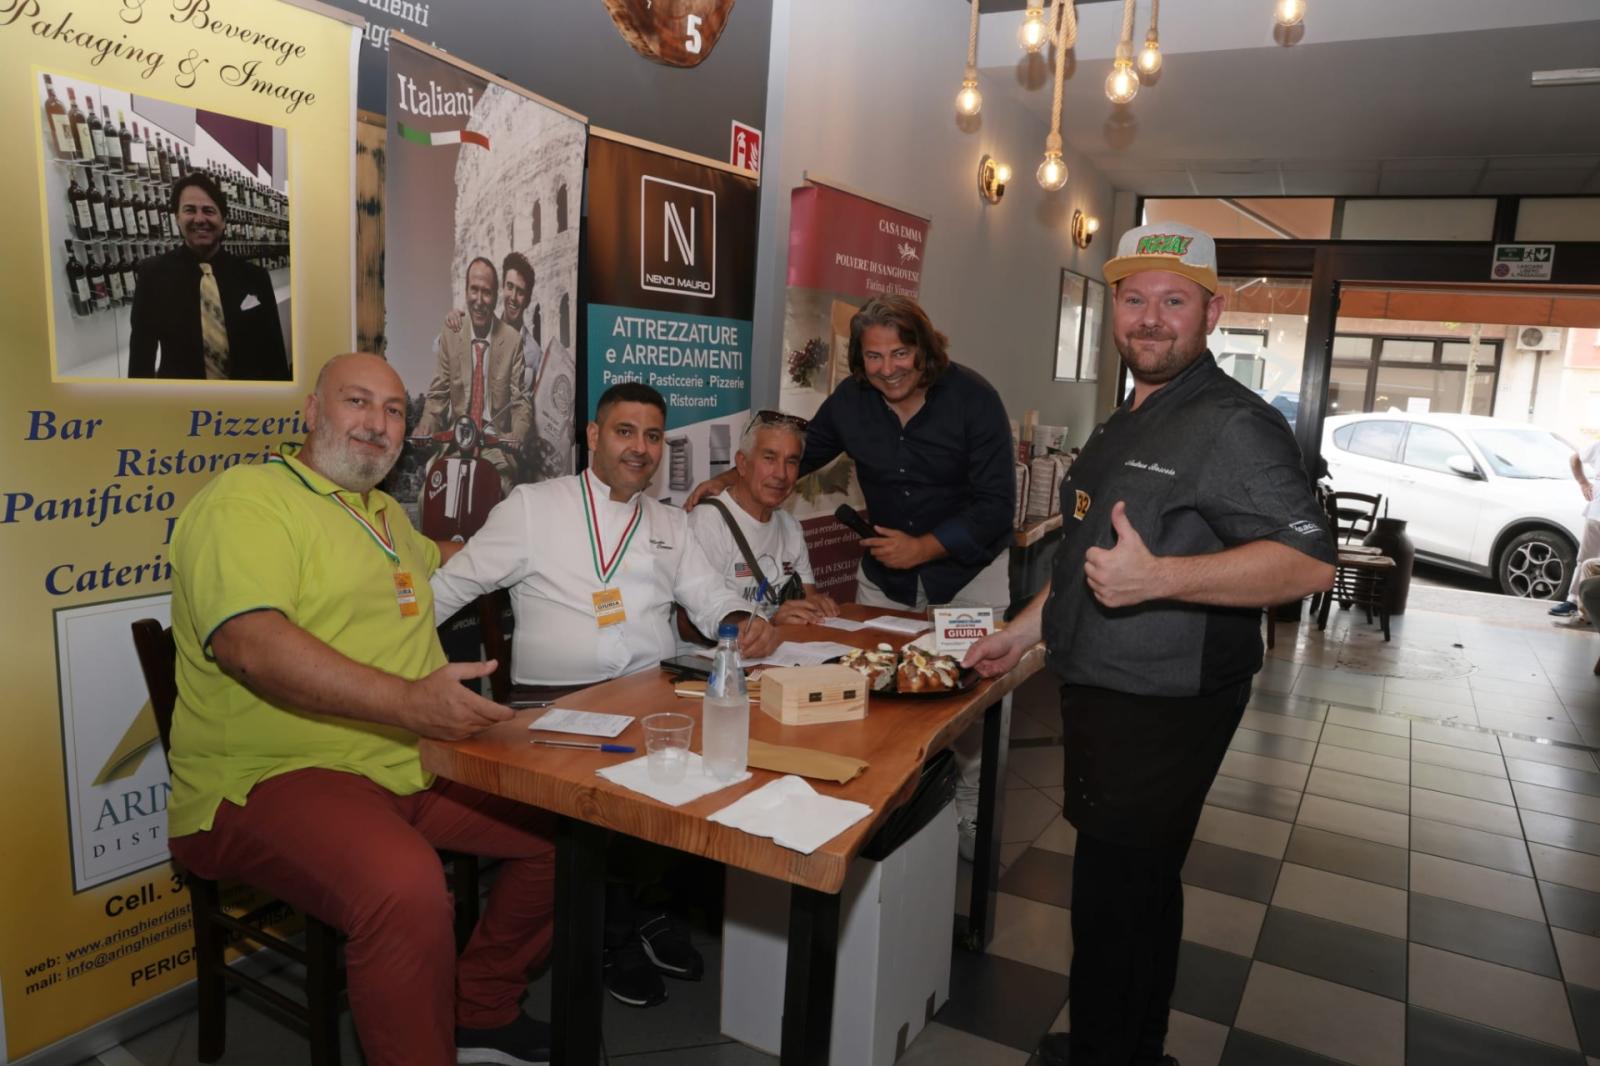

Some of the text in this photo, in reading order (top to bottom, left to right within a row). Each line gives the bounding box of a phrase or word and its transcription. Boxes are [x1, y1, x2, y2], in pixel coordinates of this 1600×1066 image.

[170, 0, 307, 65] Beverage
[685, 14, 702, 54] 5
[0, 1, 316, 114] Pakaging & Image
[397, 73, 474, 117] Italiani
[664, 201, 696, 266] N
[879, 219, 922, 243] CASA EMMA
[835, 253, 868, 272] POLVERE
[646, 273, 710, 291] NENCI MAURO
[612, 316, 738, 346] ATTREZZATURE
[605, 344, 743, 370] e ARREDAMENTI
[603, 370, 744, 389] Panifici Pasticcerie Pizzerie
[670, 393, 717, 407] Ristoranti
[24, 410, 103, 441] Bar
[114, 445, 270, 478] Ristorazi
[0, 484, 175, 527] Panificio
[948, 629, 983, 638] GIURIA
[92, 782, 172, 832] ARI
[93, 826, 160, 859] DIST
[105, 874, 184, 917] Cell. 3
[24, 904, 192, 977] web: www.aringhieridist
[25, 918, 193, 995] mail: info@aringhieridist
[130, 947, 198, 987] PERIG
